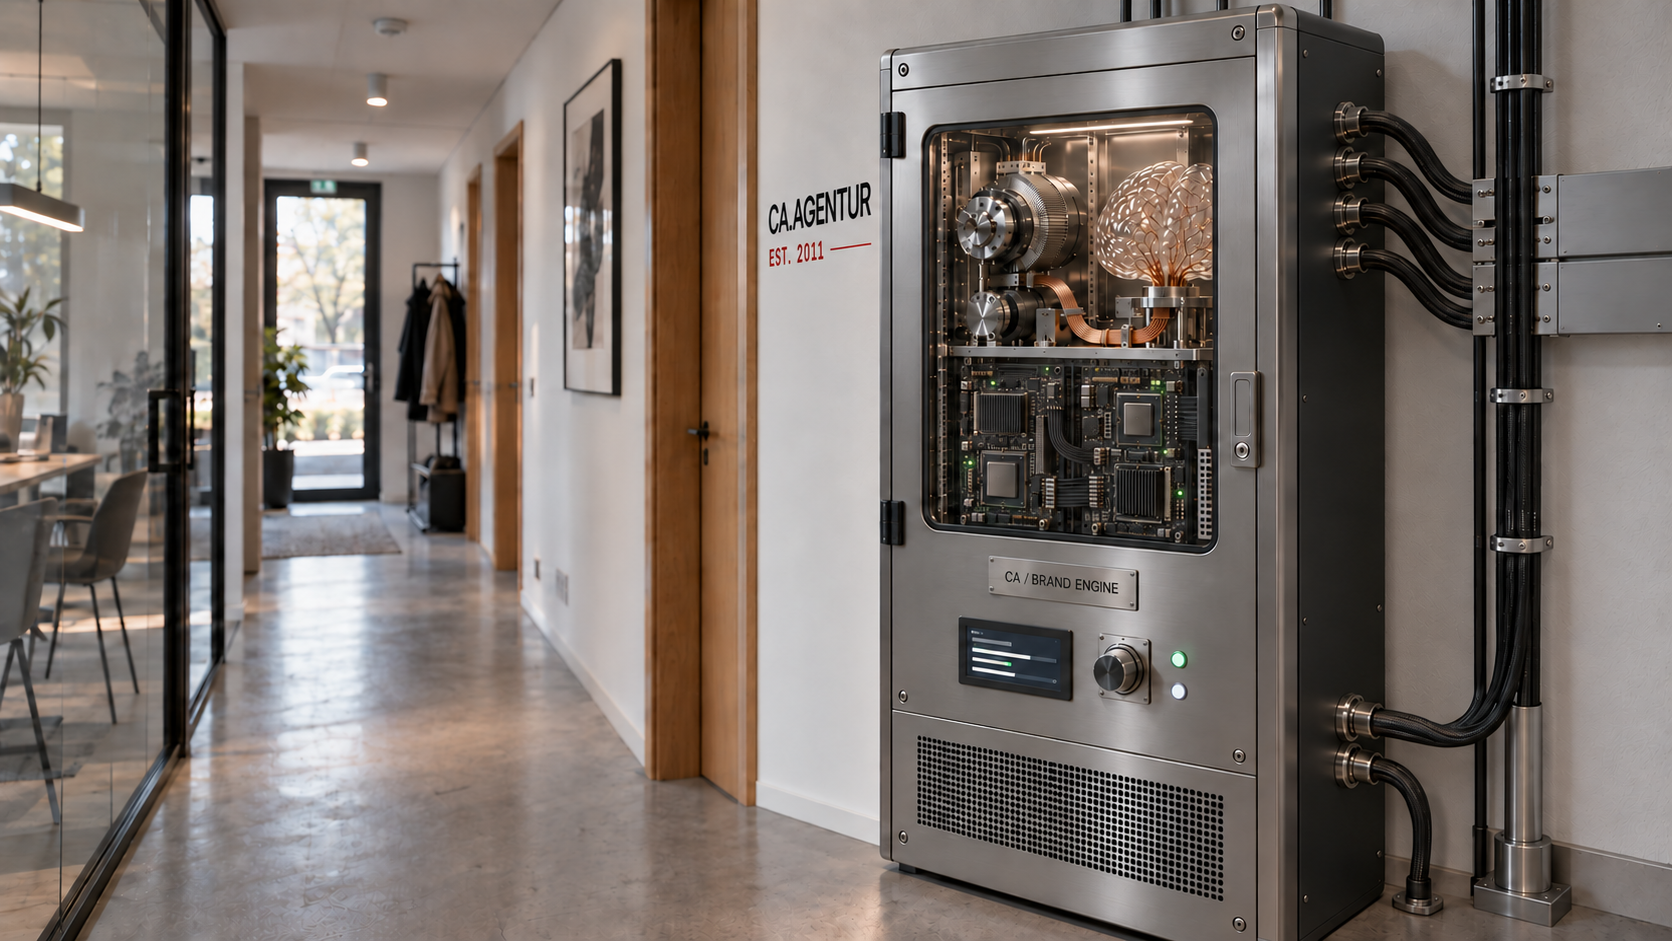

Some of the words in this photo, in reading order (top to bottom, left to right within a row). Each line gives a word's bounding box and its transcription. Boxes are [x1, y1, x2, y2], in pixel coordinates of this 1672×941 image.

[768, 181, 871, 235] CA.AGENTUR
[769, 246, 791, 267] EST.
[797, 240, 824, 263] 2011
[1005, 570, 1021, 583] CA
[1024, 573, 1030, 585] /
[1031, 573, 1071, 589] BRAND
[1075, 578, 1119, 594] ENGINE
